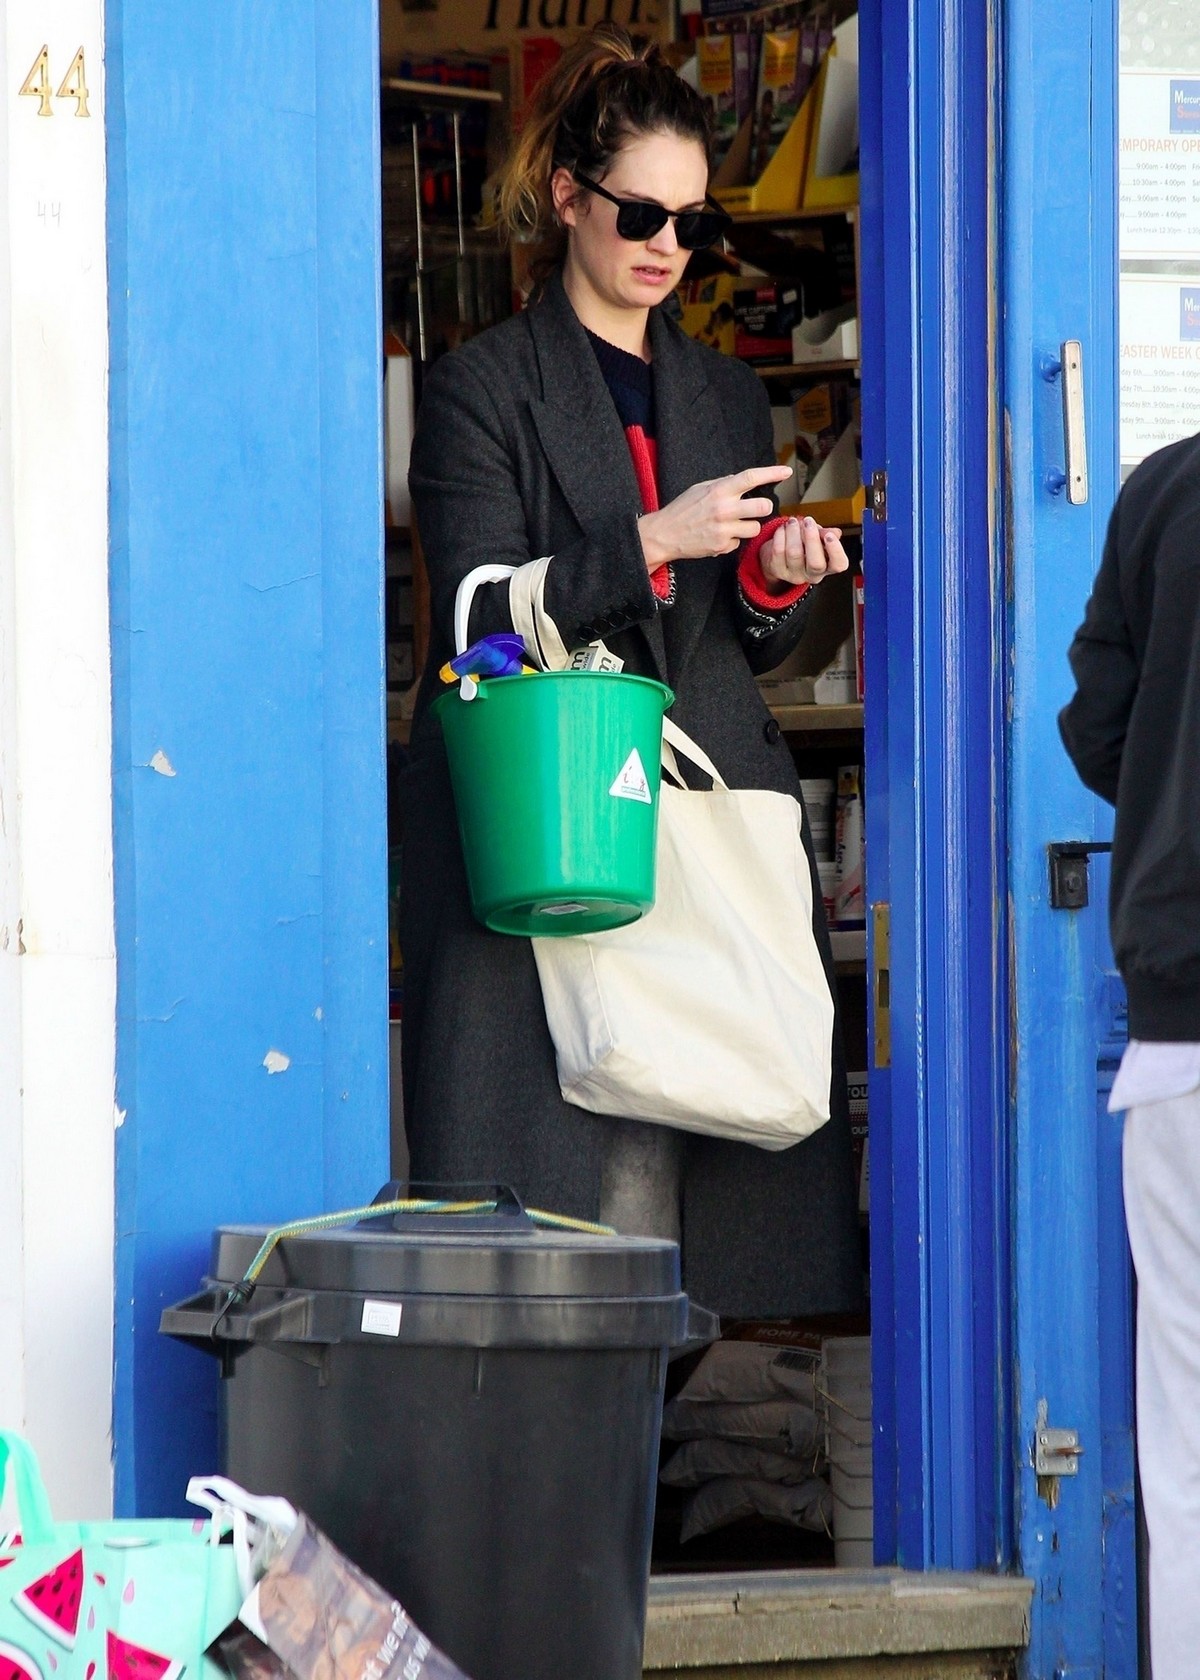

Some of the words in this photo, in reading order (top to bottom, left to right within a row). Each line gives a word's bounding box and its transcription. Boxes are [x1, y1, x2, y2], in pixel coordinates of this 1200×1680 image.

[18, 43, 91, 118] 44
[36, 199, 62, 228] 44
[1160, 345, 1193, 360] WEEK
